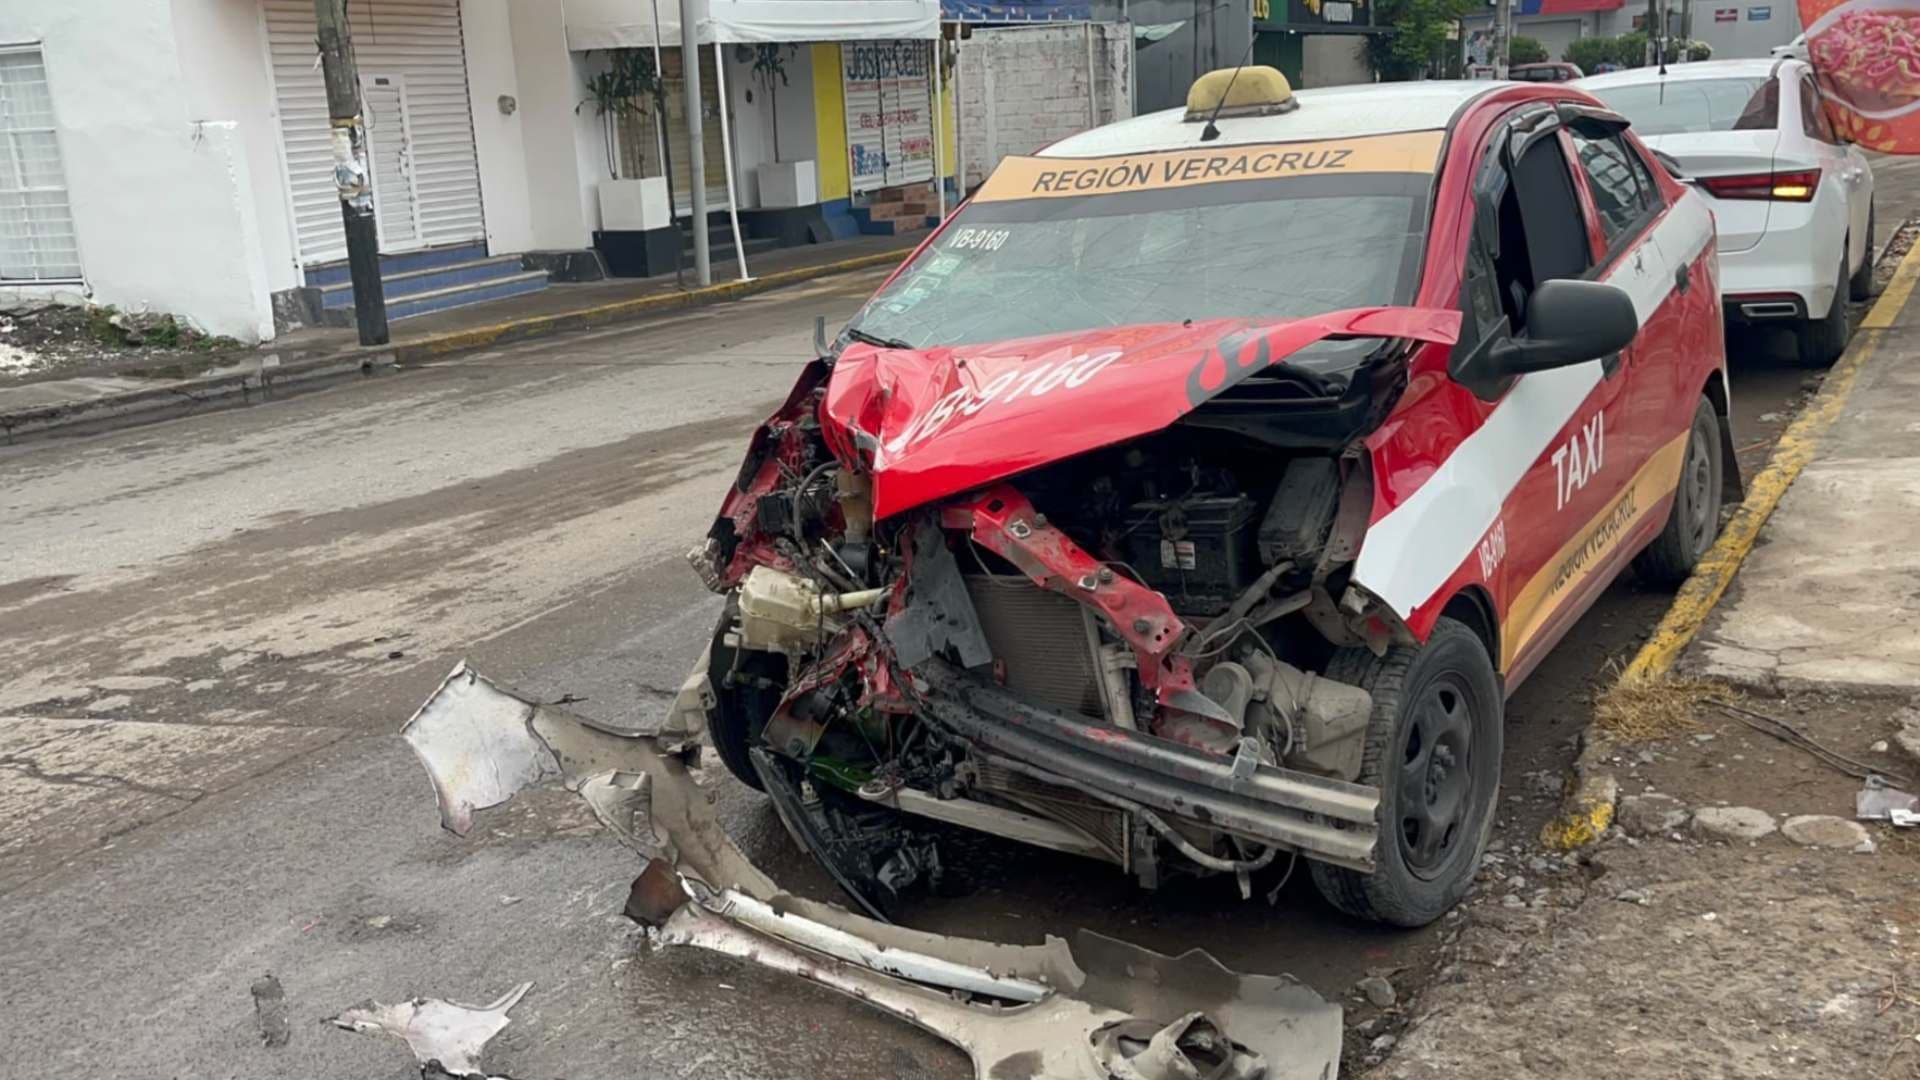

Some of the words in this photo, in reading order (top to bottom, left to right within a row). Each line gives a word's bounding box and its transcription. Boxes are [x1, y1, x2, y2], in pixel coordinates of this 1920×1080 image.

[1032, 160, 1154, 192] REGIÓN
[1162, 150, 1353, 182] VERACRUZ
[950, 229, 1010, 250] VB-9160
[1551, 410, 1603, 511] TAXI
